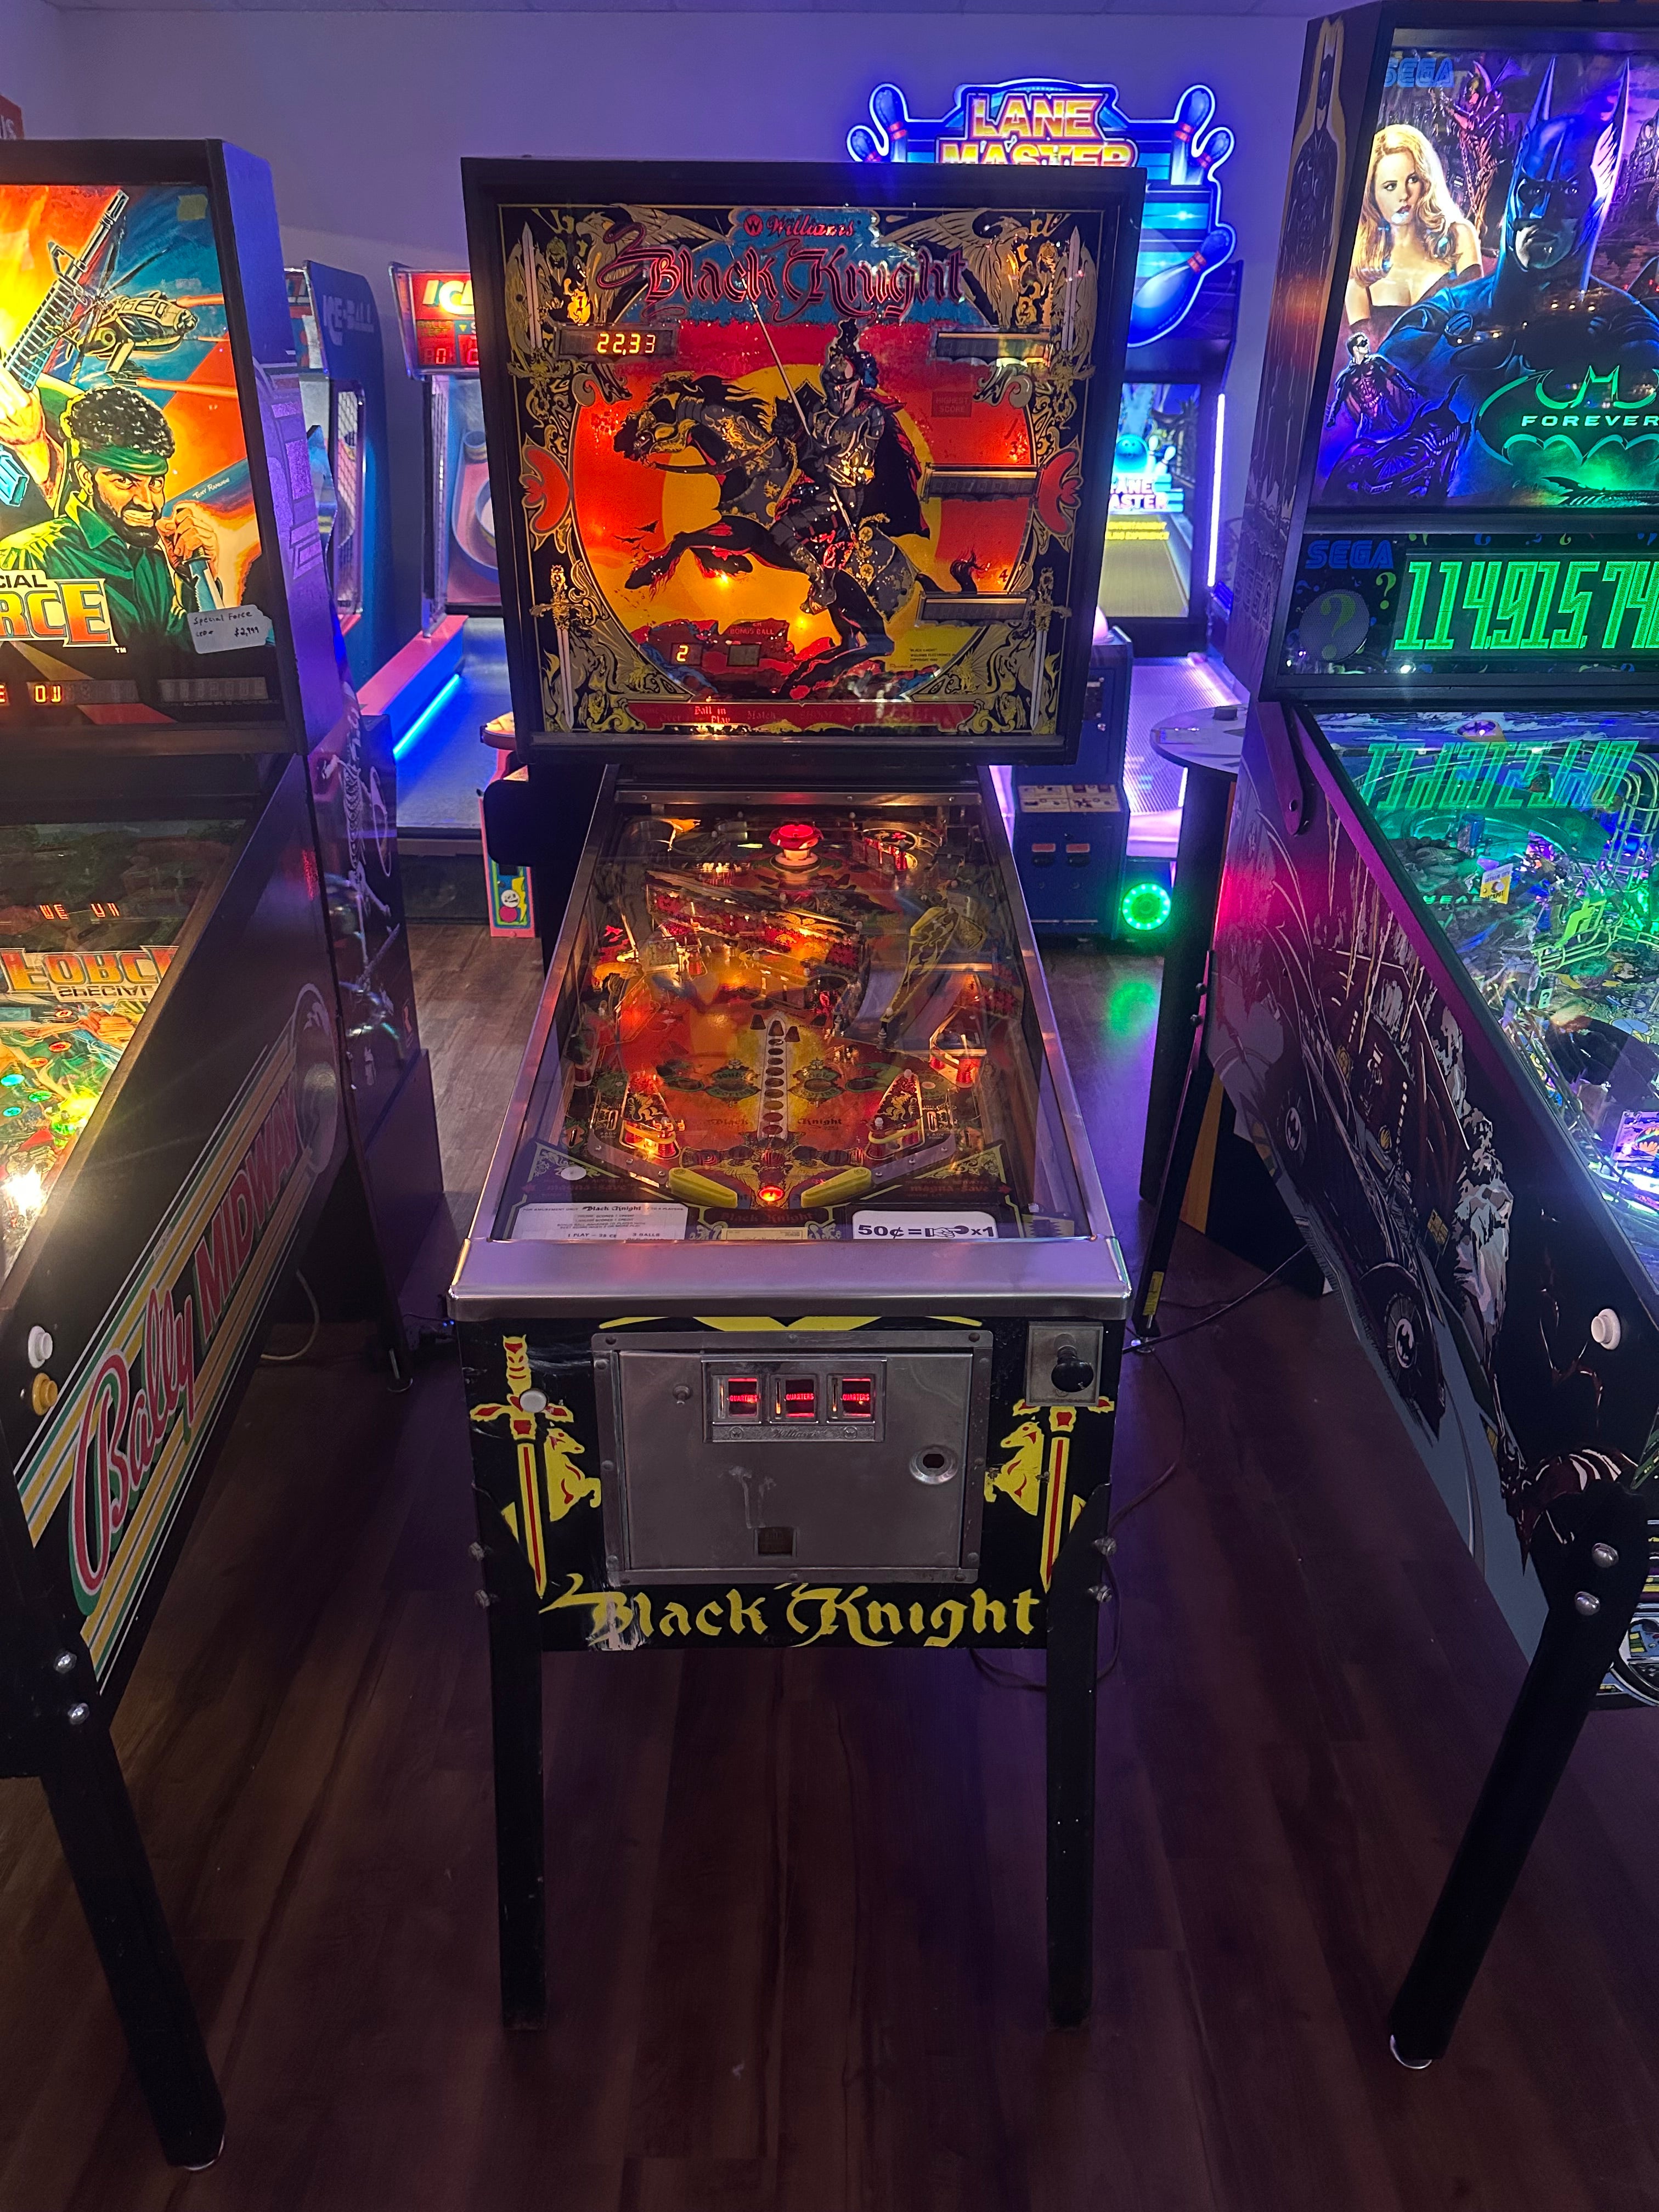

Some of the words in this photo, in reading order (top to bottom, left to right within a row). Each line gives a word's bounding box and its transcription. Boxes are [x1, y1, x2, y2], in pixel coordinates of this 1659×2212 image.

[1384, 57, 1454, 88] SEGA
[972, 97, 1100, 138] LANE
[939, 142, 1136, 167] MASTER
[766, 214, 855, 236] Williams
[598, 241, 779, 305] Black
[772, 243, 967, 325] Knight
[1521, 415, 1659, 426] FOREVER
[1110, 478, 1154, 494] ANE
[1108, 494, 1167, 509] ASTER
[1305, 540, 1394, 569] SEGA
[193, 614, 224, 626] Special
[228, 611, 253, 621] Force
[675, 645, 689, 662] 2
[694, 706, 713, 715] Ball
[716, 707, 726, 715] in
[710, 715, 731, 724] Play
[719, 1212, 758, 1222] Black
[765, 1211, 814, 1223] Knight
[70, 1286, 196, 1596] Bally
[539, 1573, 768, 1646] Black
[775, 1583, 1040, 1647] Knight
